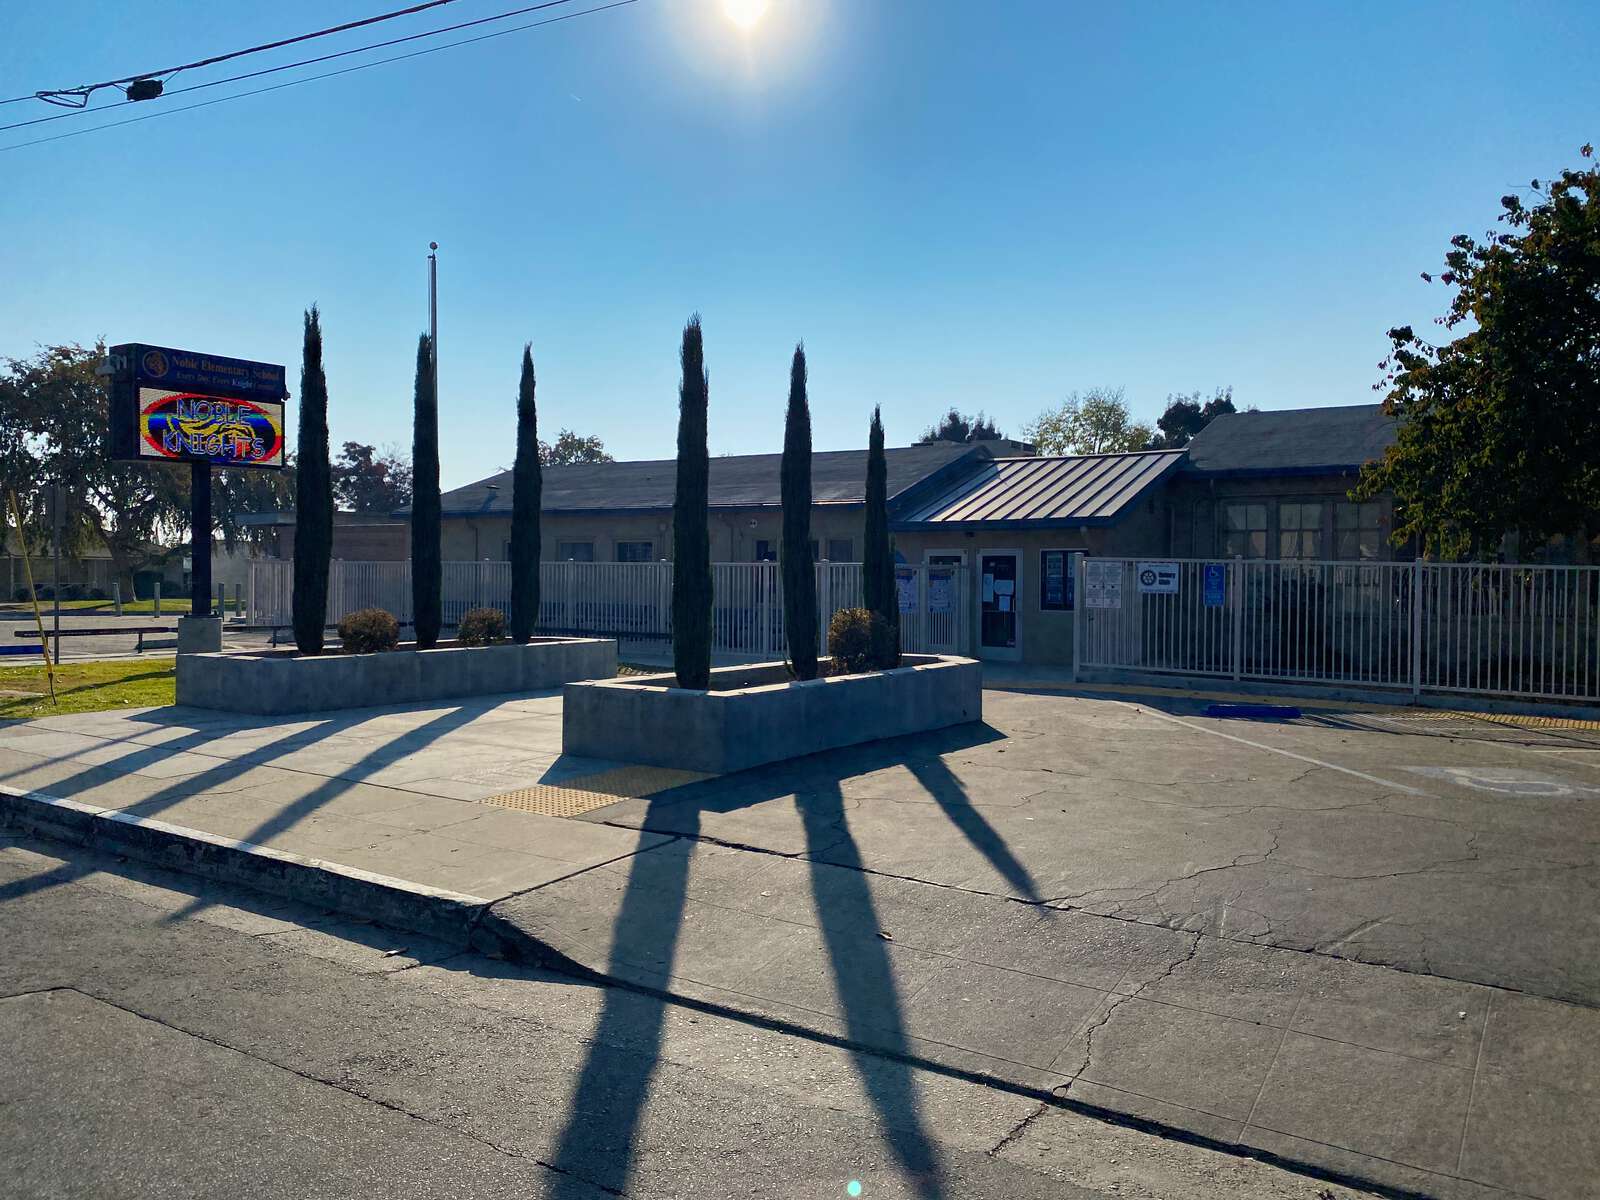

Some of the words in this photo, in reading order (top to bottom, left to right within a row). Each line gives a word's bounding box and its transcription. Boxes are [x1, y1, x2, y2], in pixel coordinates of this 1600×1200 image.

[172, 355, 199, 369] Noble
[201, 360, 250, 377] Elementary
[176, 398, 251, 426] NOBLE
[162, 429, 266, 458] KNIGHTS
